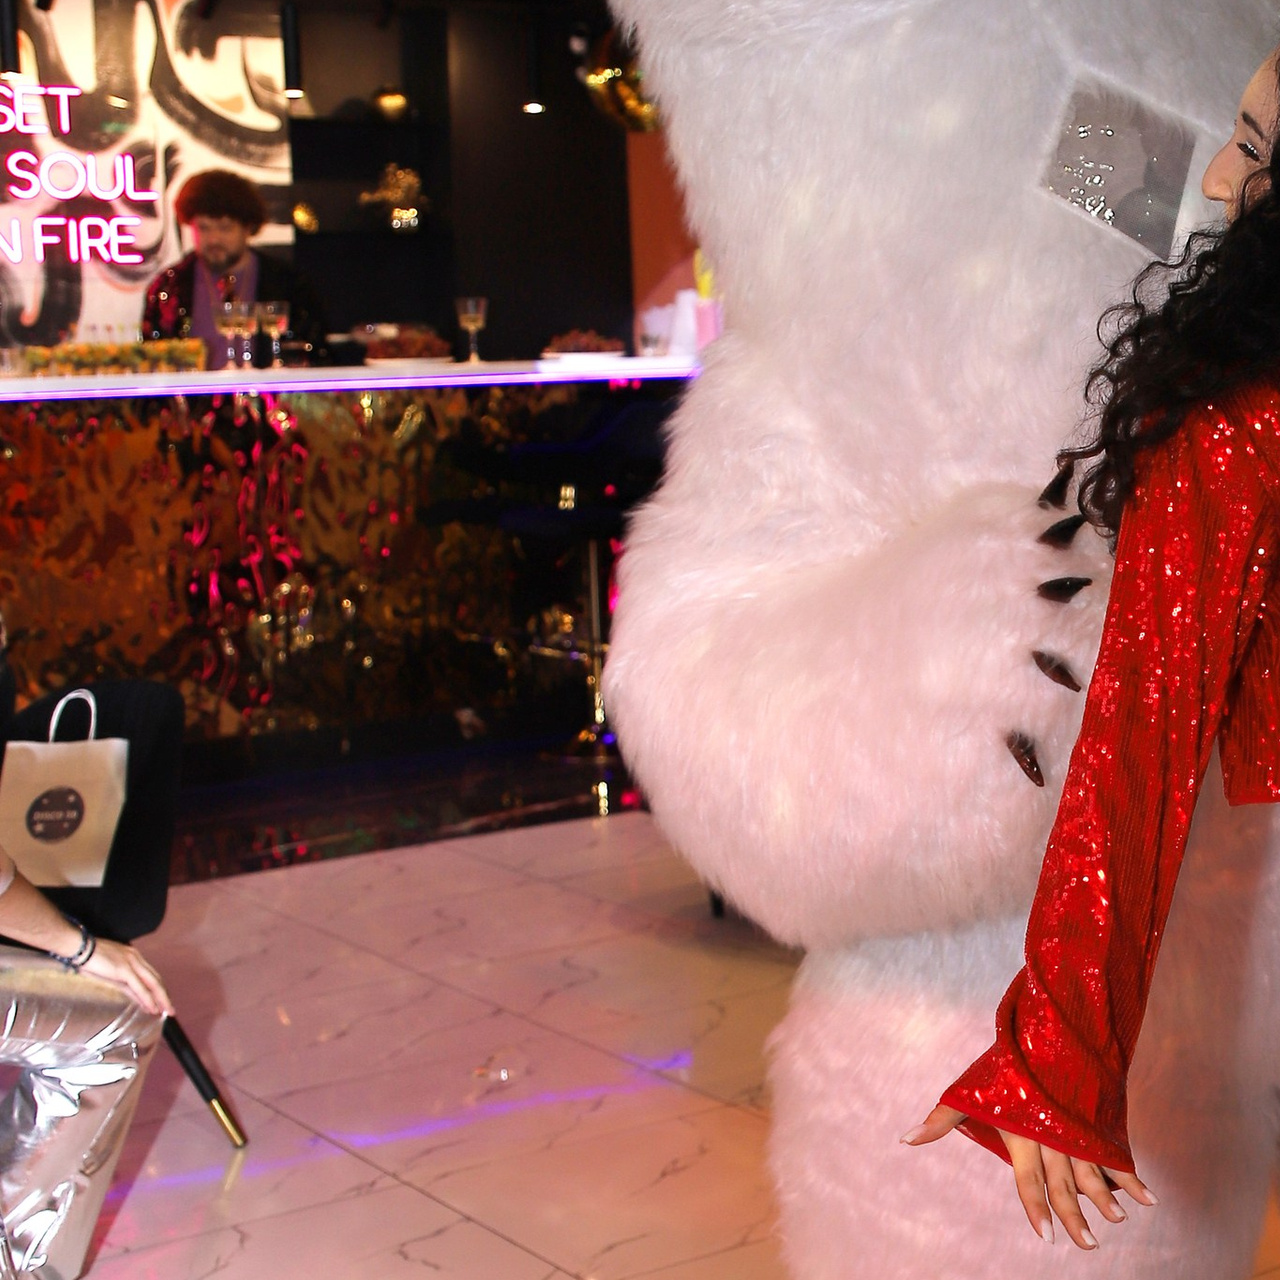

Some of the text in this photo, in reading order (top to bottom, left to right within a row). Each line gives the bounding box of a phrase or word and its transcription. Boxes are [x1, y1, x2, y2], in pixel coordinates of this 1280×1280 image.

[0, 83, 82, 135] SET
[6, 150, 160, 200] SOUL
[0, 215, 144, 265] N FIRE
